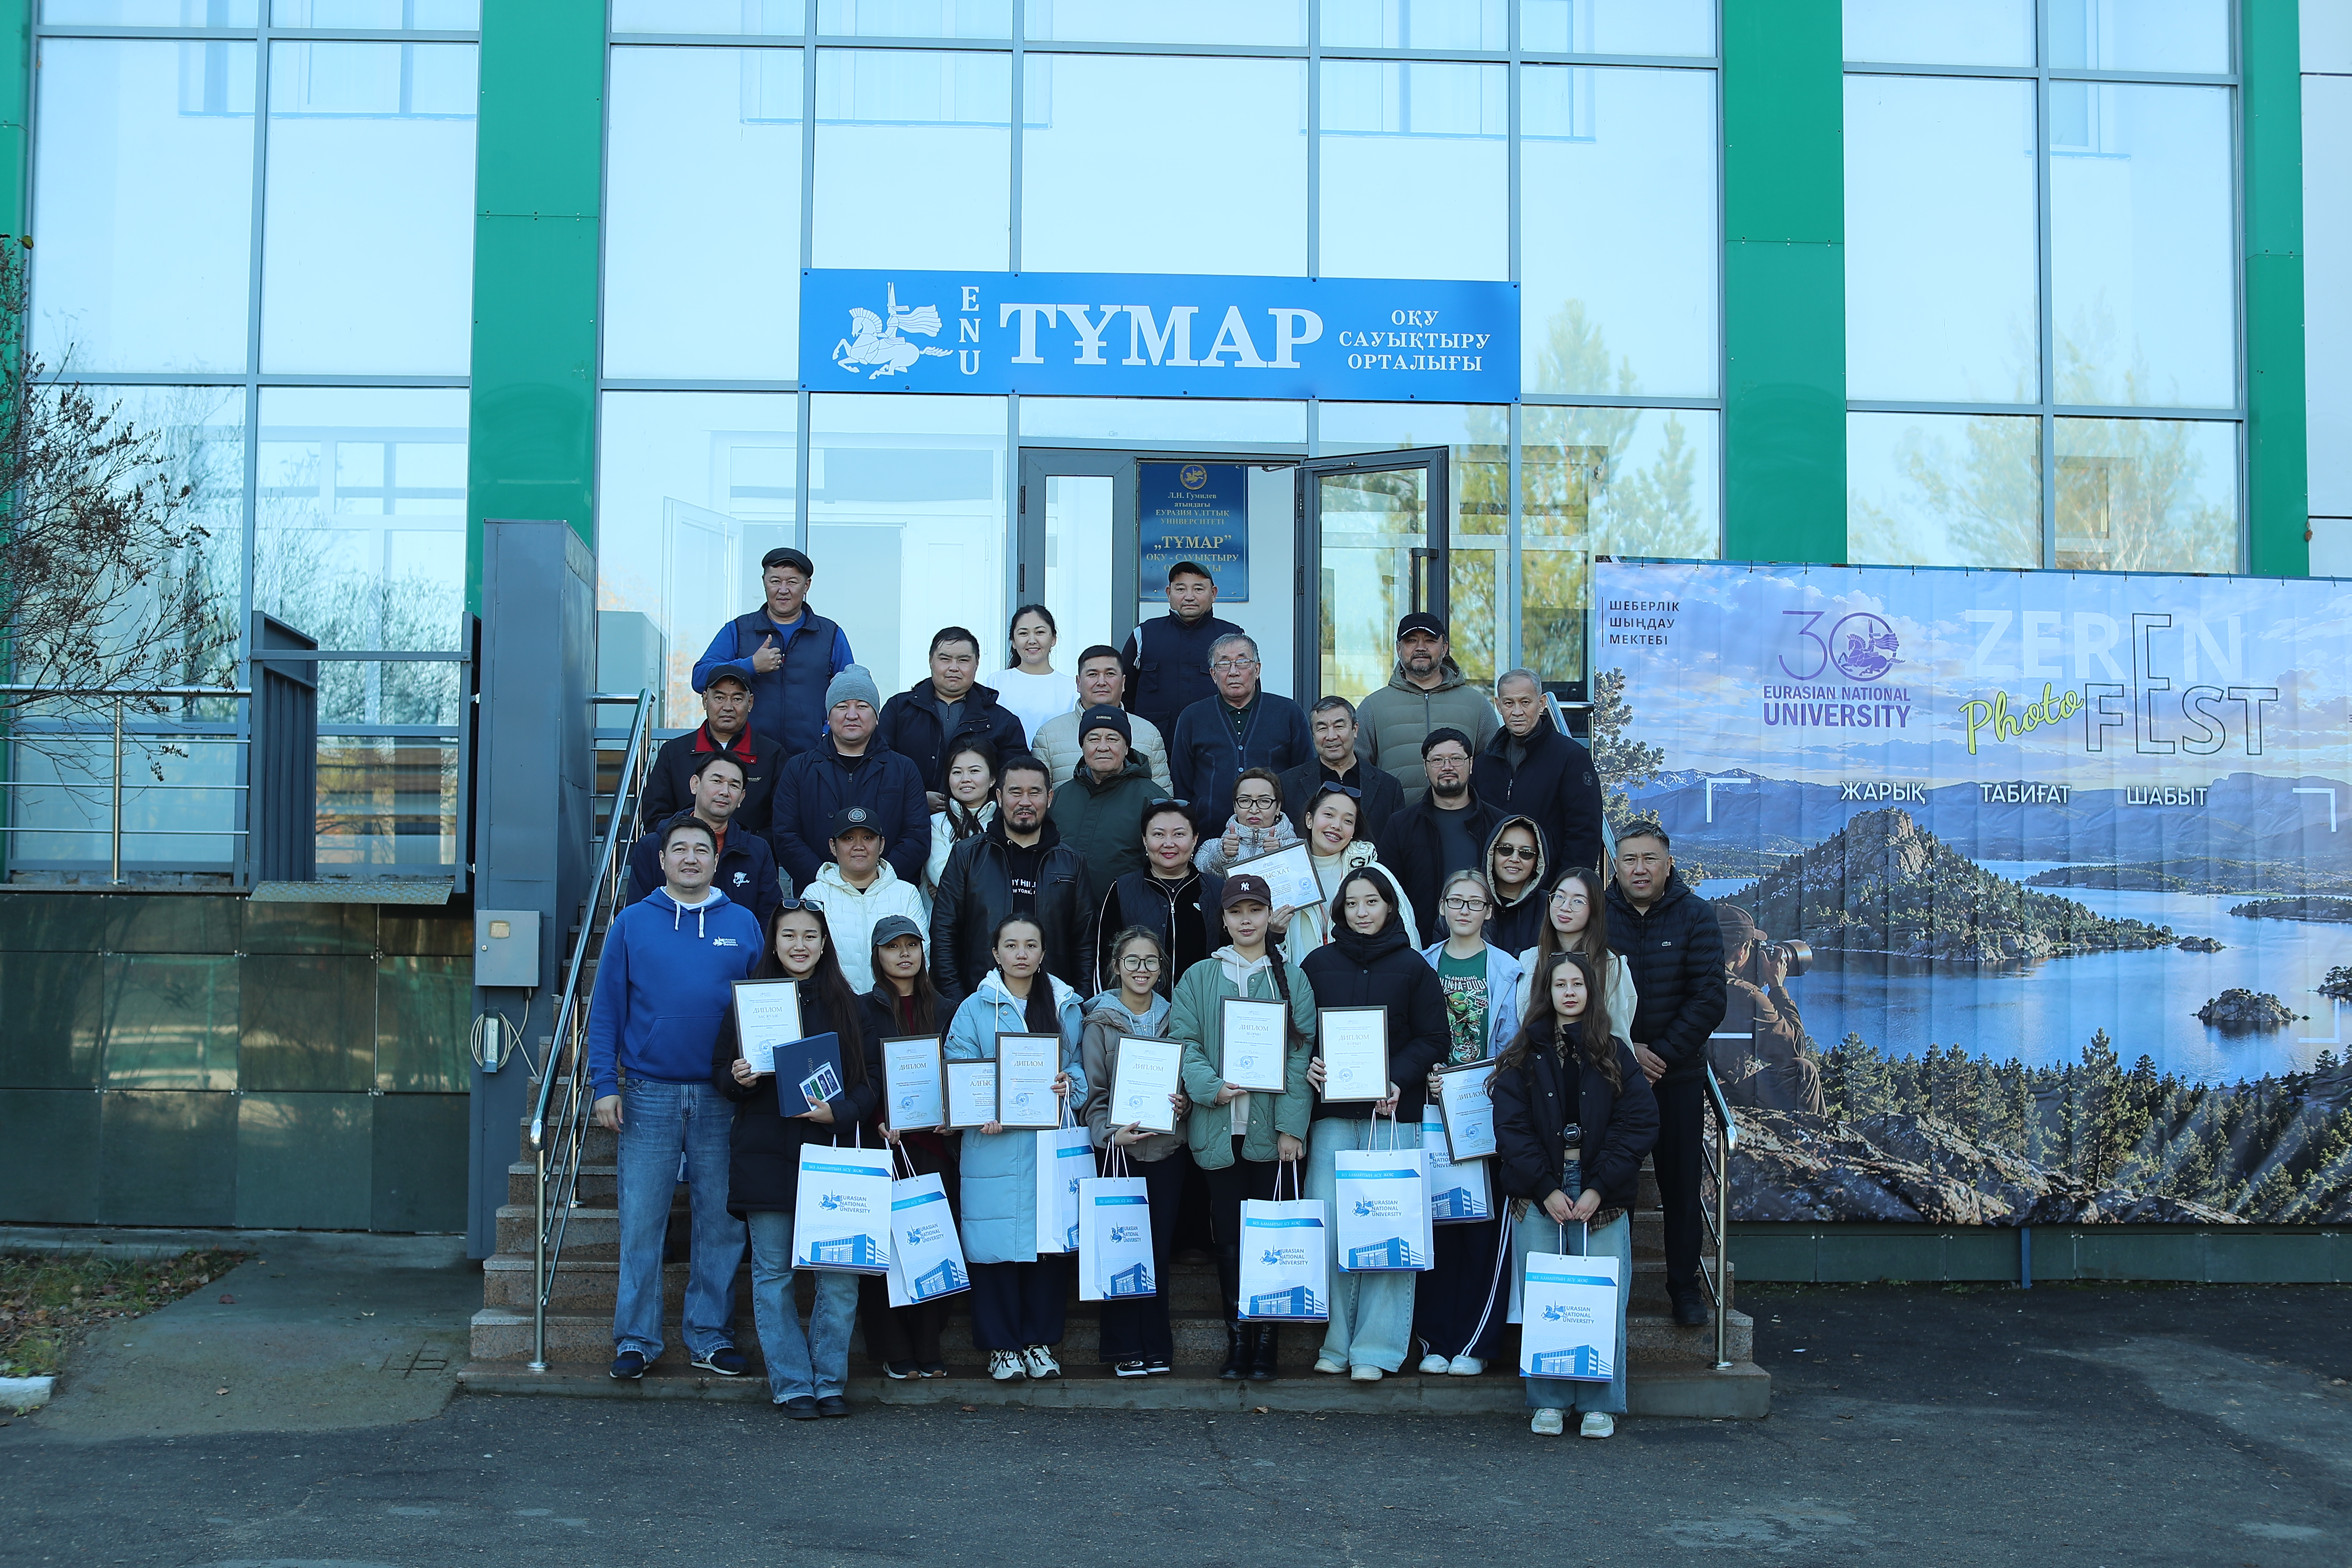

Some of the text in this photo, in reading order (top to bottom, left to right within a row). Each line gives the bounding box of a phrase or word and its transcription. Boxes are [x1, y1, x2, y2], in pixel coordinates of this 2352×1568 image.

[1391, 310, 1439, 328] ОҚУ
[959, 286, 980, 376] ENU
[999, 303, 1323, 368] ТҰМАР
[1338, 331, 1491, 351] САУЫҚТЫРУ
[1347, 352, 1482, 372] ОРТАЛЫҒЫ
[1610, 601, 1679, 612] ШЕБЕРЛІК
[1610, 618, 1675, 630] ШЫҢДАУ
[1610, 634, 1668, 645] МЕКТЕБІ
[1764, 685, 1911, 701] EURASIAN NATIONAL
[1764, 703, 1911, 728] UNIVERSITY
[1959, 682, 2084, 755] Photo
[1841, 781, 2207, 806] ЖАРЫҚ ТАБИҒАТ ШАБЫТ
[899, 1063, 926, 1071] ДИПЛОМ
[1132, 1063, 1164, 1072] ДИПЛОМ
[1457, 1090, 1485, 1101] ДИПЛОМ
[919, 1223, 938, 1232] EURASIAN
[920, 1229, 940, 1237] NATIONAL
[922, 1234, 944, 1243] UNIVERSITY
